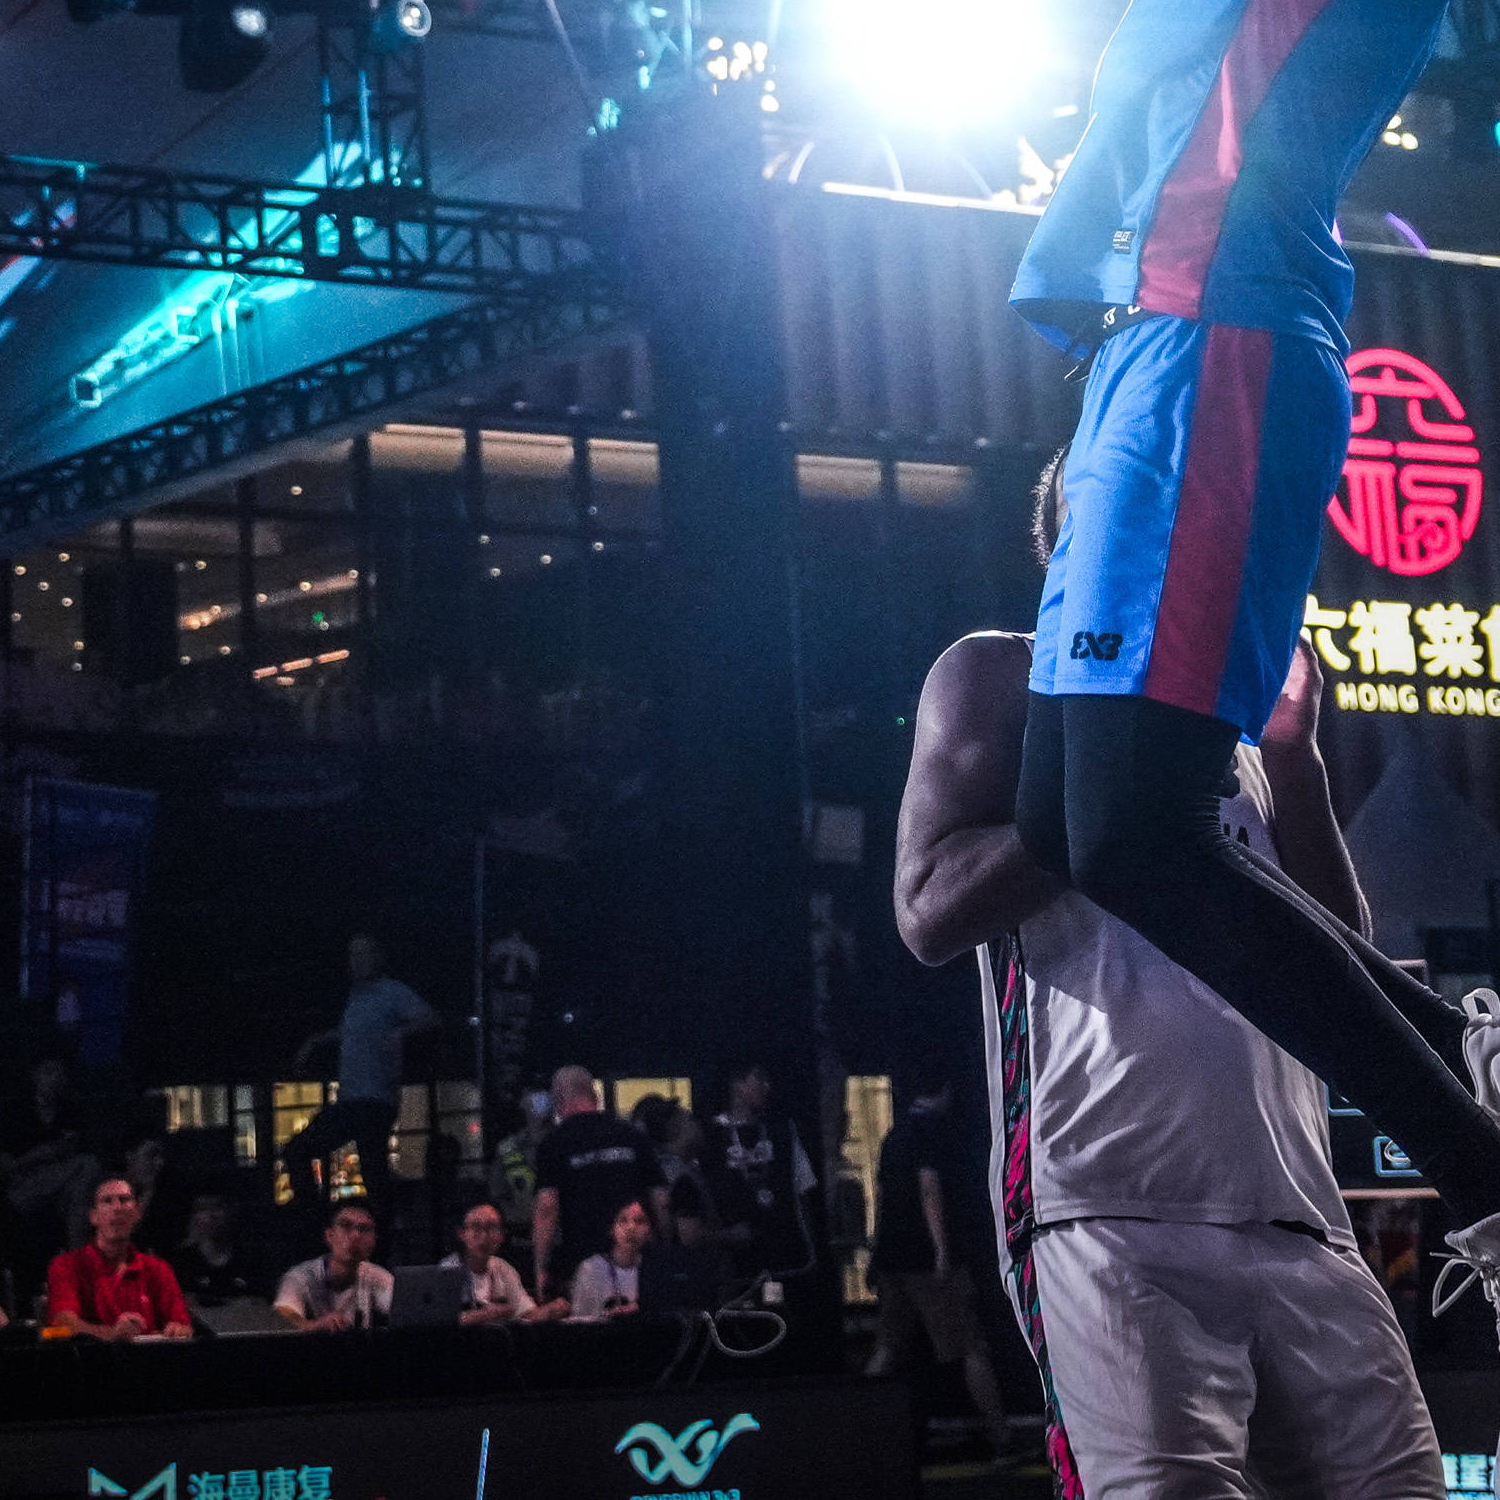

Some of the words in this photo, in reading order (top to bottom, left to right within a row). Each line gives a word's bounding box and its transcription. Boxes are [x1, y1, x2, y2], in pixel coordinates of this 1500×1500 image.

[1335, 681, 1419, 714] HONG
[188, 1465, 333, 1500] 海曼康复
